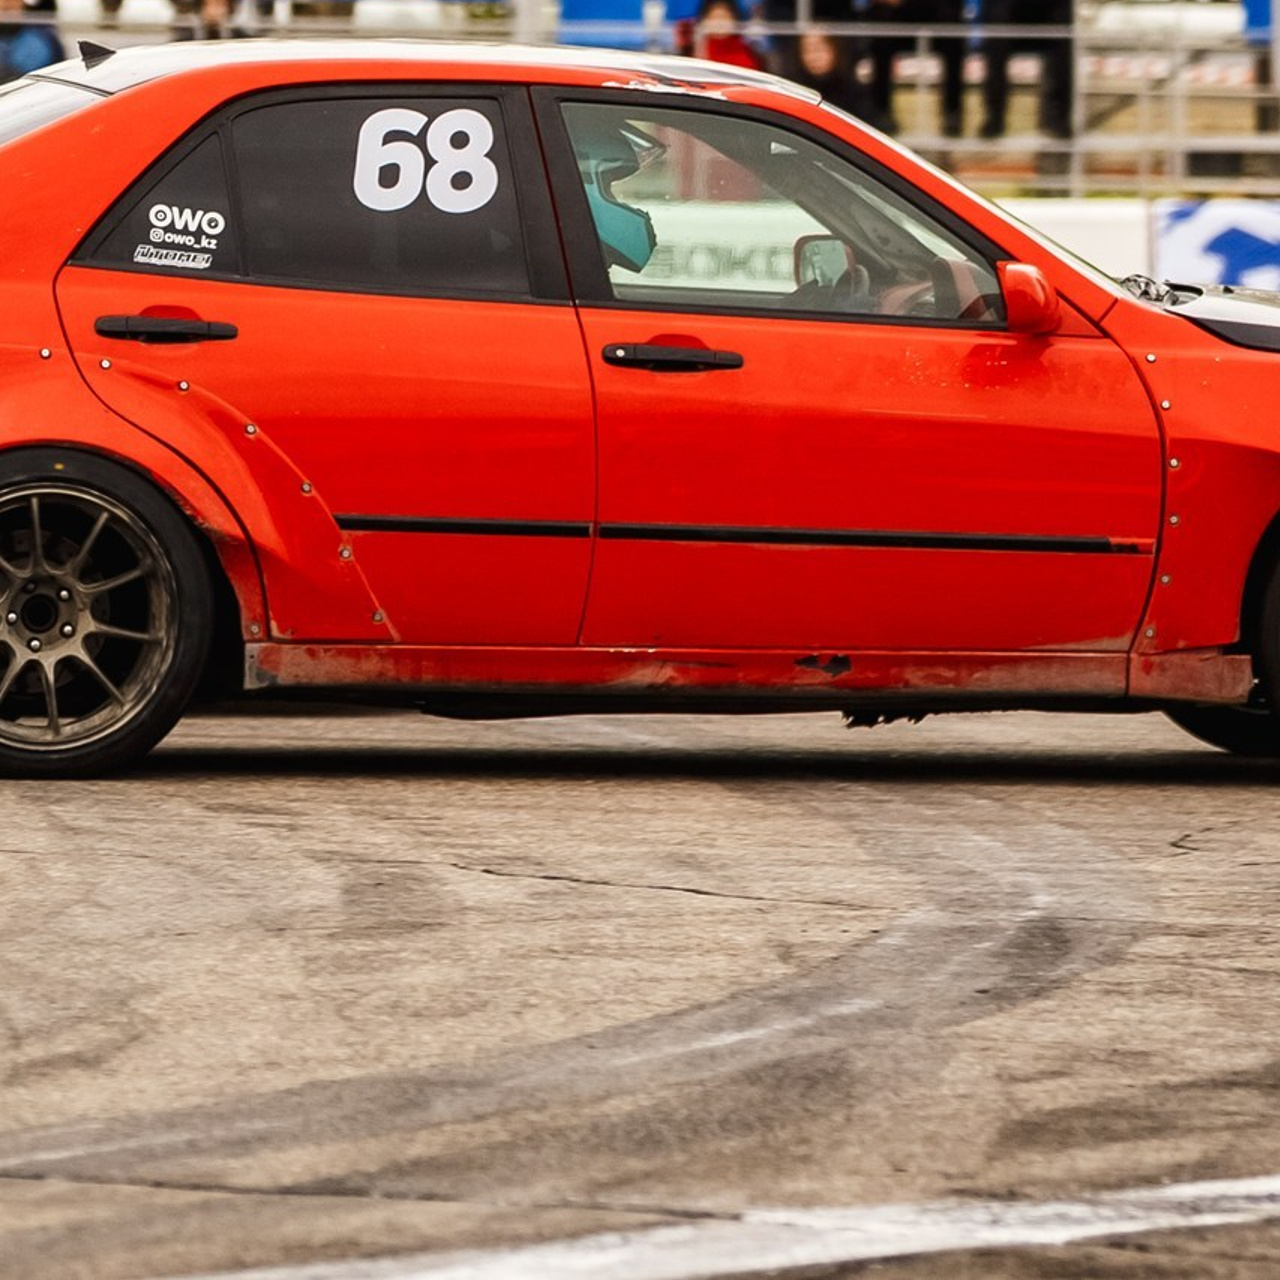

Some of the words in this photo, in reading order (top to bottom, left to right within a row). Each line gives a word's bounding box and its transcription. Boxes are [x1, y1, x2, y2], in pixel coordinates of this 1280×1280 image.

[354, 108, 499, 214] 68
[149, 204, 225, 235] OWO
[165, 232, 218, 250] owo_kz
